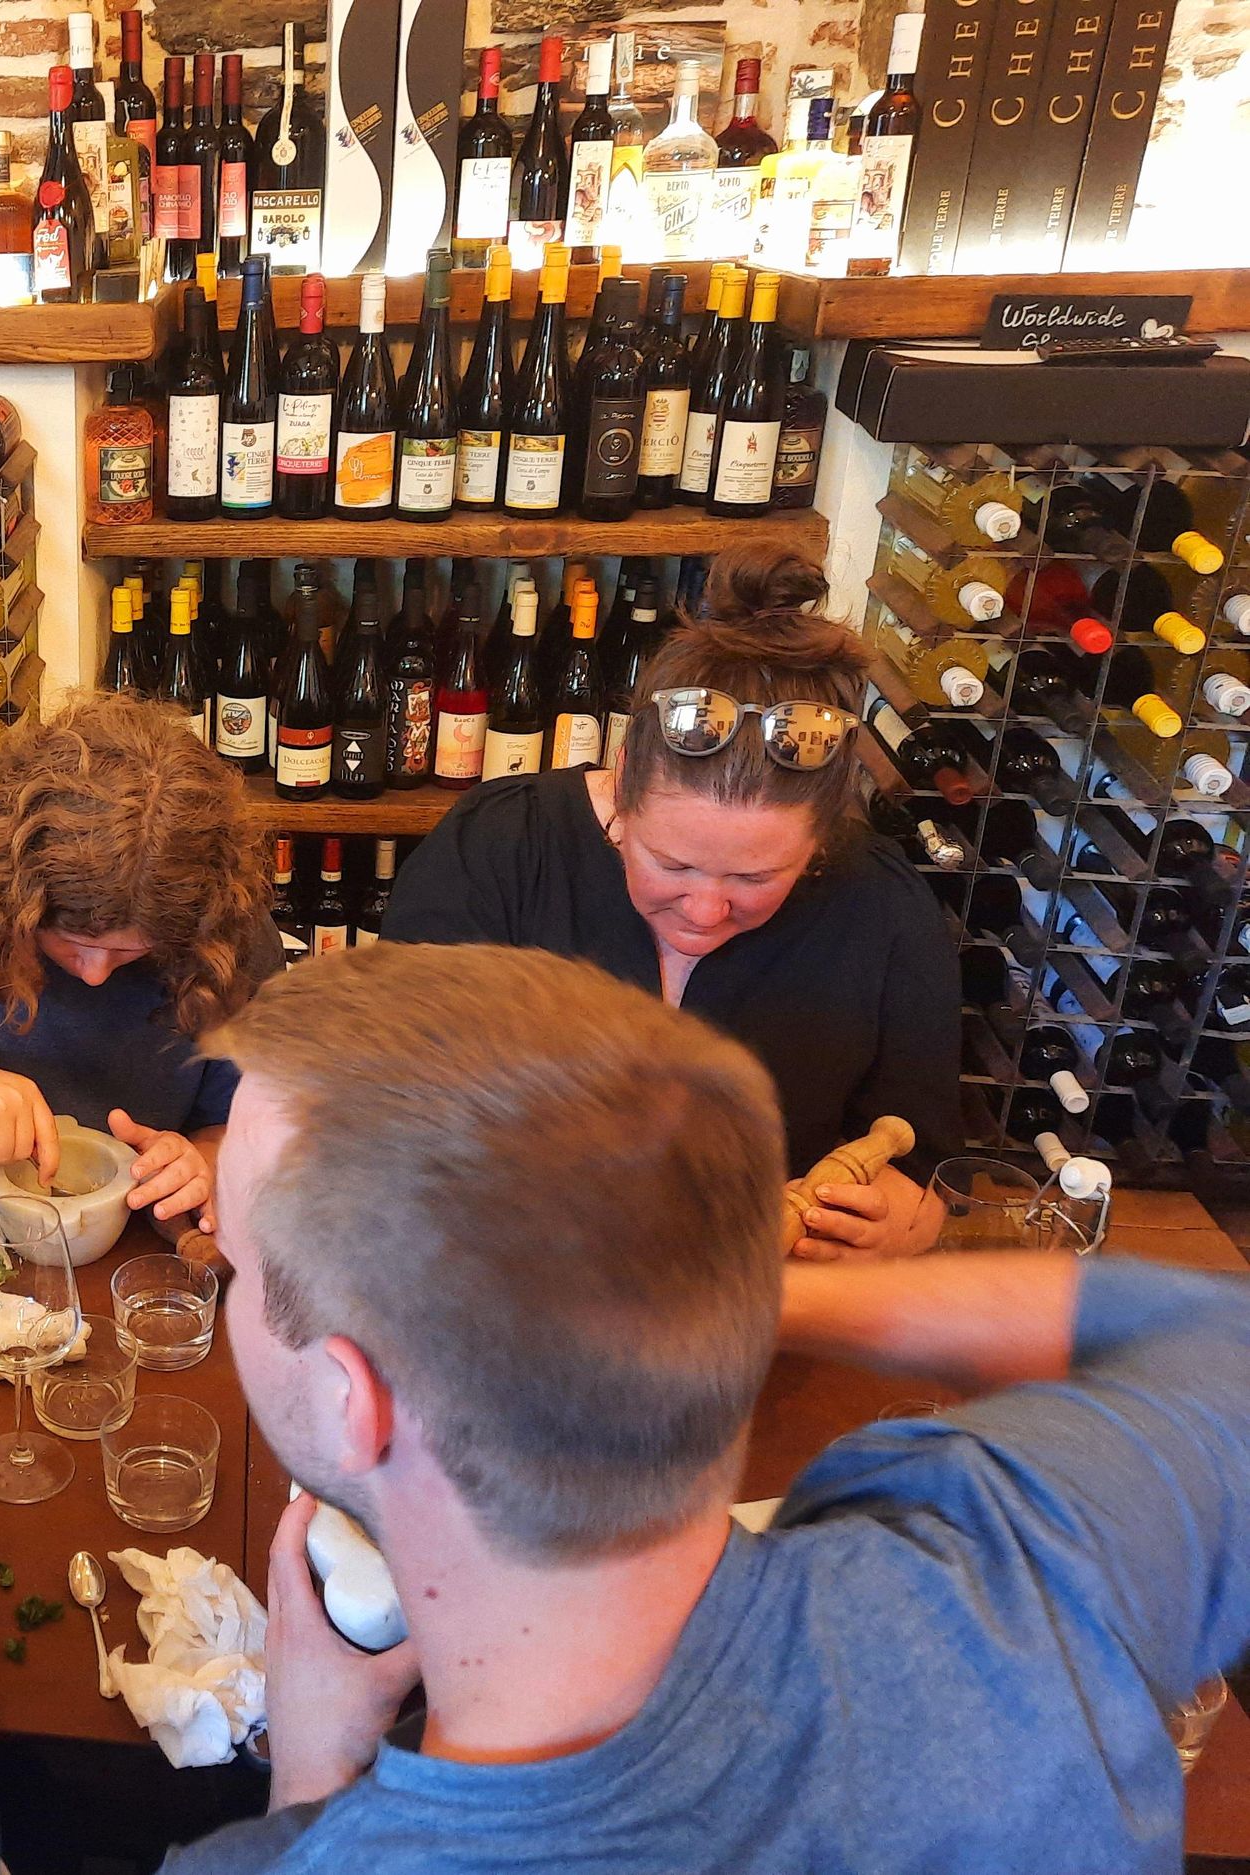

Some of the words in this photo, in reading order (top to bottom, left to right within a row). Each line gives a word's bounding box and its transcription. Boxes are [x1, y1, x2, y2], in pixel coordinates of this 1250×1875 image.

[932, 0, 981, 128] CHE
[990, 0, 1040, 126] CHE
[1048, 0, 1101, 124] CHE
[262, 214, 306, 223] BAROLO
[934, 190, 951, 232] TERRE
[992, 187, 1009, 230] TERRE
[1047, 186, 1066, 229] TERRE
[1108, 183, 1128, 226] TERRE
[1002, 302, 1127, 328] Worldwide
[643, 432, 680, 446] ERCIÒ
